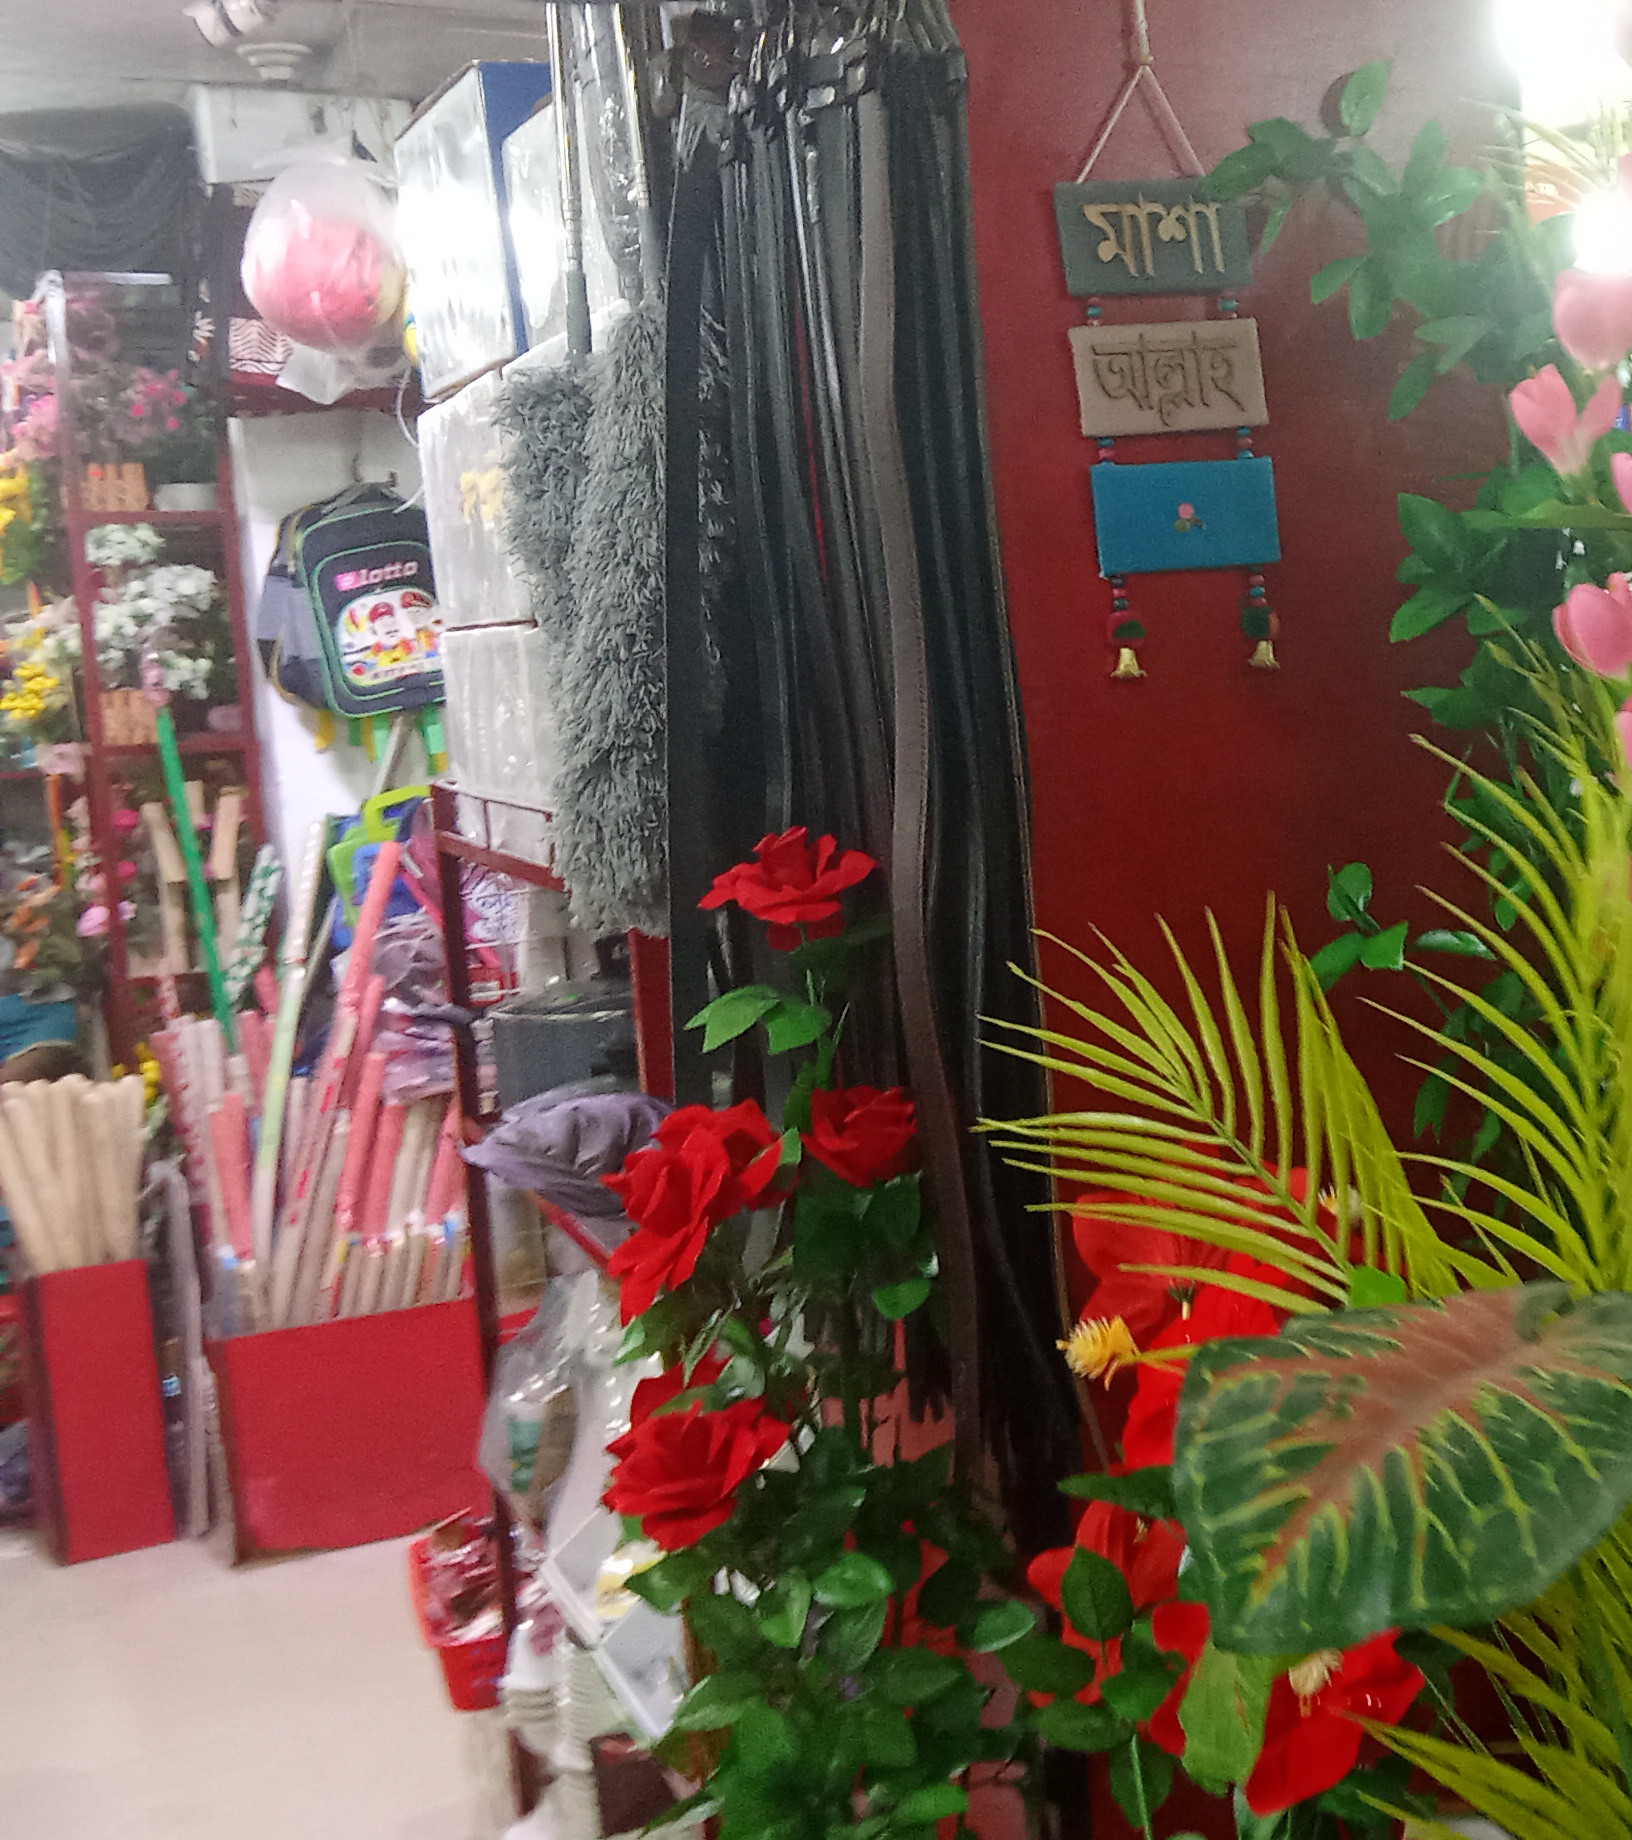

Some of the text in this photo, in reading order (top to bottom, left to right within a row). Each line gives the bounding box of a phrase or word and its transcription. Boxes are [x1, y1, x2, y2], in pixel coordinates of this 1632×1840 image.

[1083, 193, 1225, 277] মাশা
[1091, 331, 1245, 427] আল্লাহ
[360, 561, 419, 585] lotto
